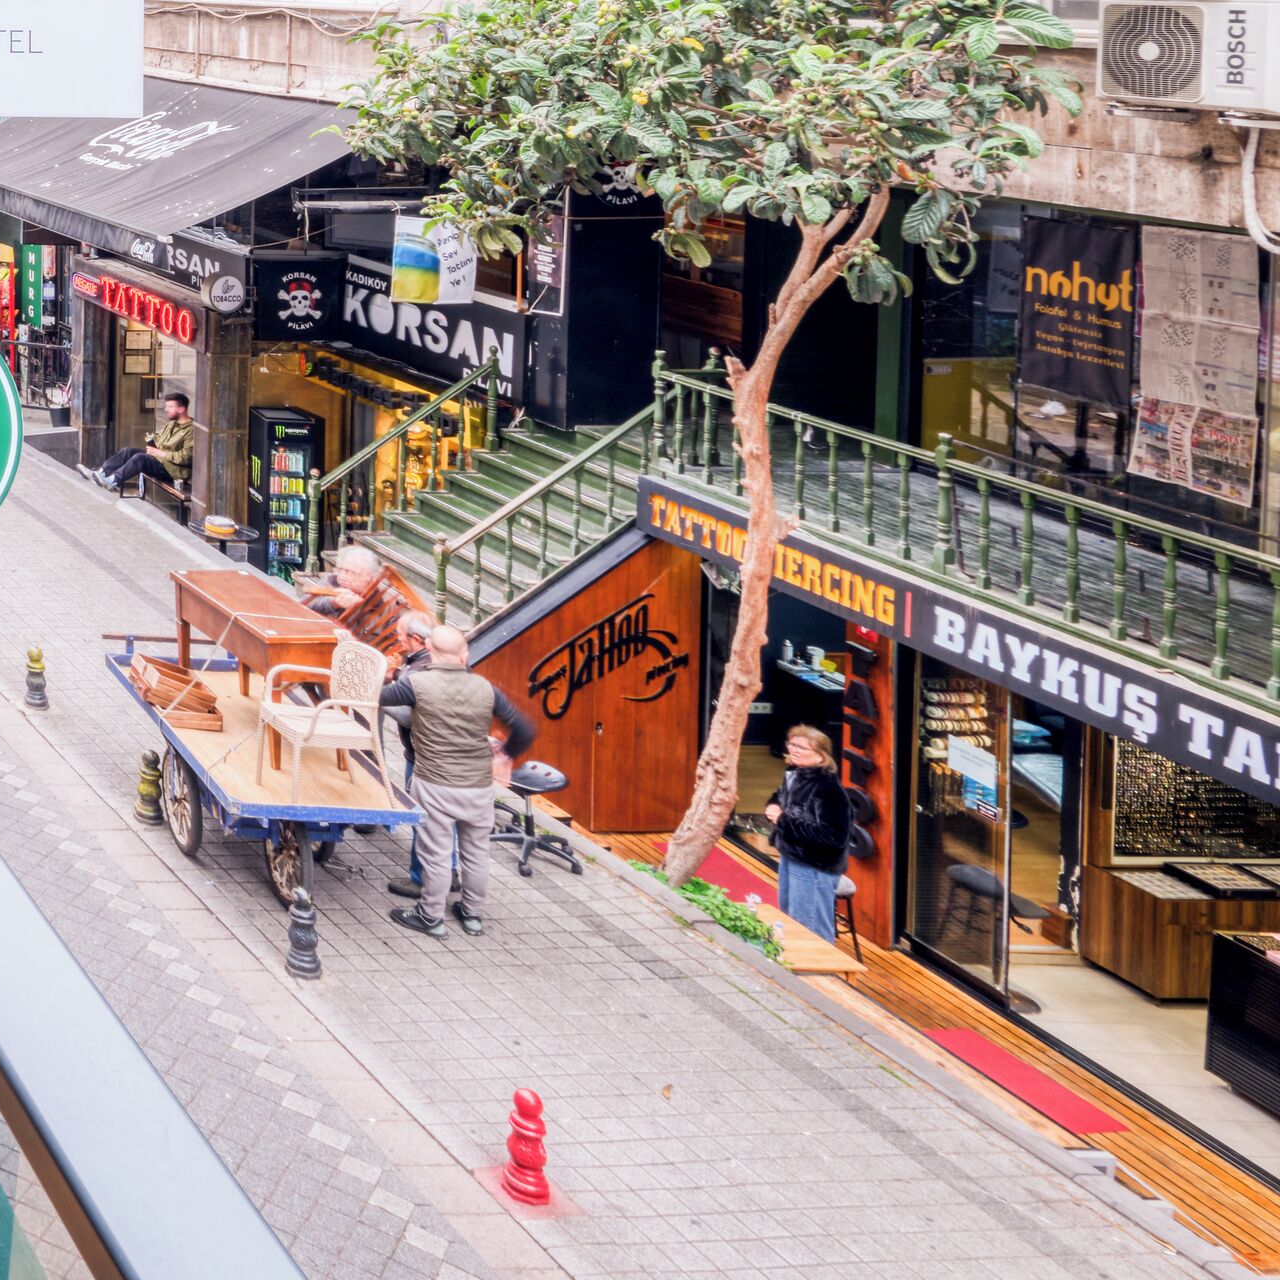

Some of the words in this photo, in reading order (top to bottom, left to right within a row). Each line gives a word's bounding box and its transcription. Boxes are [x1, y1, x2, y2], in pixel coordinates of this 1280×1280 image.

[1226, 9, 1247, 85] BOSCH
[606, 194, 638, 205] PİLAVI
[166, 244, 220, 278] RSAN
[442, 250, 458, 262] Sev
[27, 251, 36, 318] MURG
[281, 271, 317, 283] KORSAN
[345, 270, 388, 292] KADIKÖY
[1025, 261, 1133, 313] nohut
[100, 276, 192, 343] TATTOO
[213, 295, 242, 303] TOBACCO
[288, 321, 314, 331] PİLAVI
[343, 283, 514, 379] KORSAN
[1034, 302, 1068, 318] Falafel
[1072, 309, 1082, 321] &
[1087, 313, 1123, 330] Humus
[462, 367, 512, 398] PLVI
[773, 543, 896, 627] IERCING
[933, 605, 1159, 744] BAYKUŞ
[1178, 703, 1280, 789] TA
